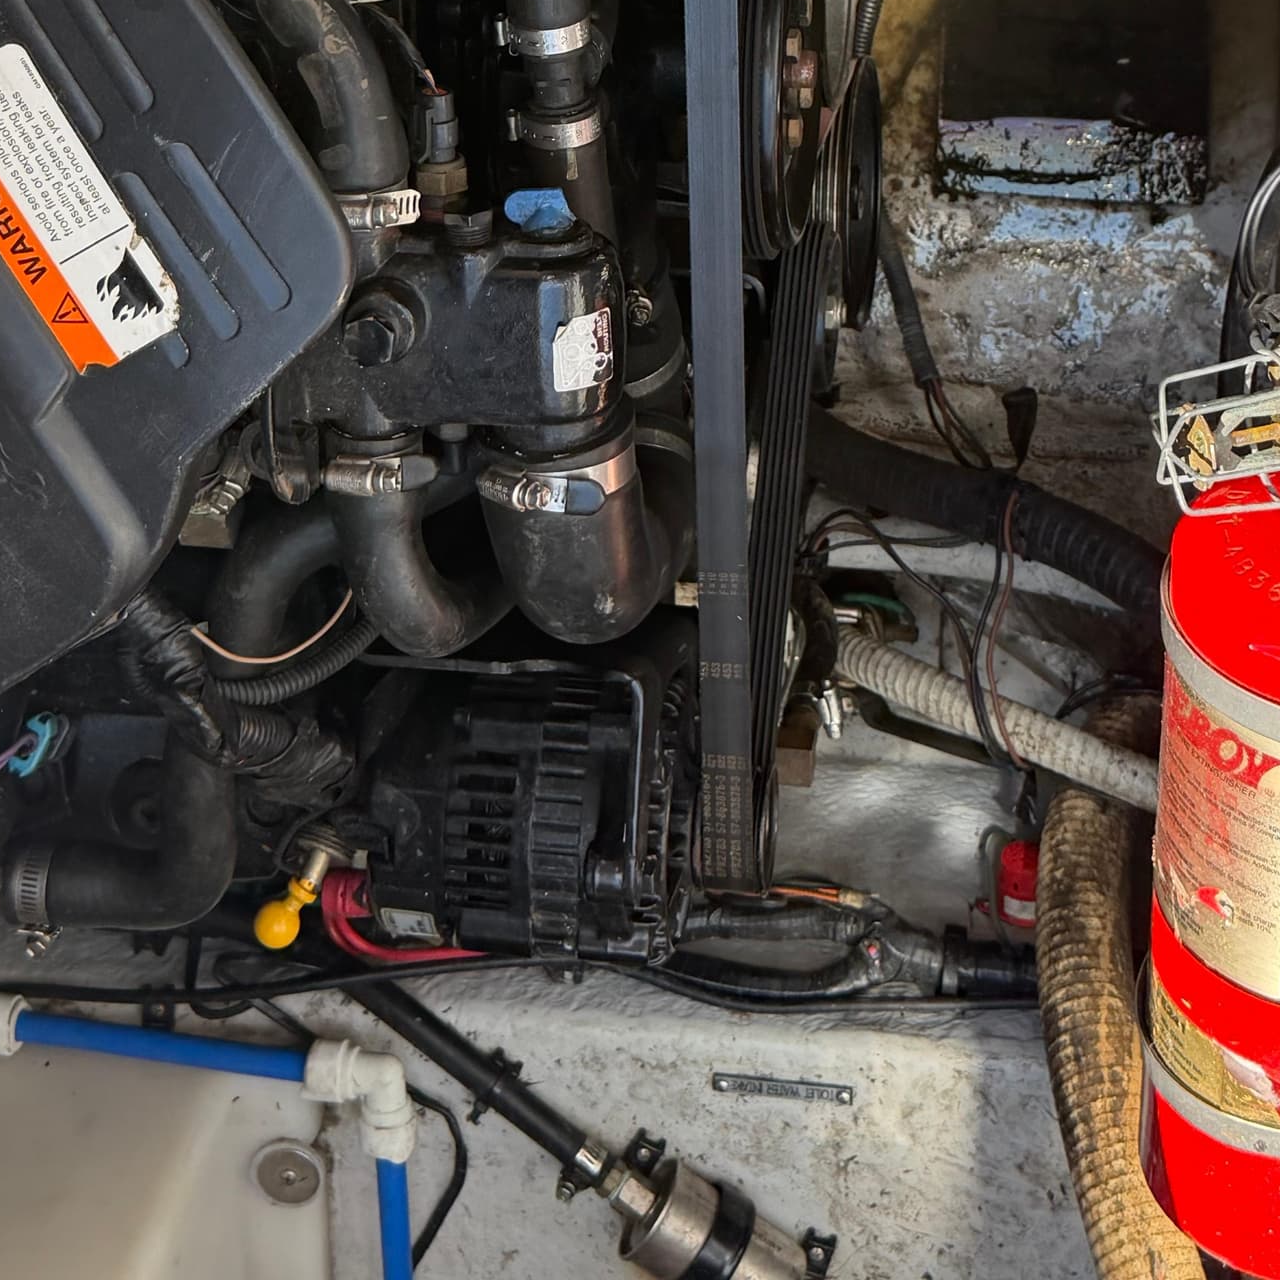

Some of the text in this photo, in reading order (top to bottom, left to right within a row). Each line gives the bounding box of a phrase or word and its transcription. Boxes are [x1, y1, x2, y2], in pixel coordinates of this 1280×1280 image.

[6, 110, 40, 154] leaking
[9, 90, 100, 222] Inspect system for leaks
[32, 153, 55, 181] from
[36, 104, 111, 215] at least once a year.
[8, 168, 41, 211] serious
[30, 174, 43, 189] or
[37, 188, 56, 210] fire
[50, 179, 88, 229] resulting
[35, 210, 62, 244] Avoid
[50, 208, 74, 237] from
[766, 1083, 799, 1097] WATER
